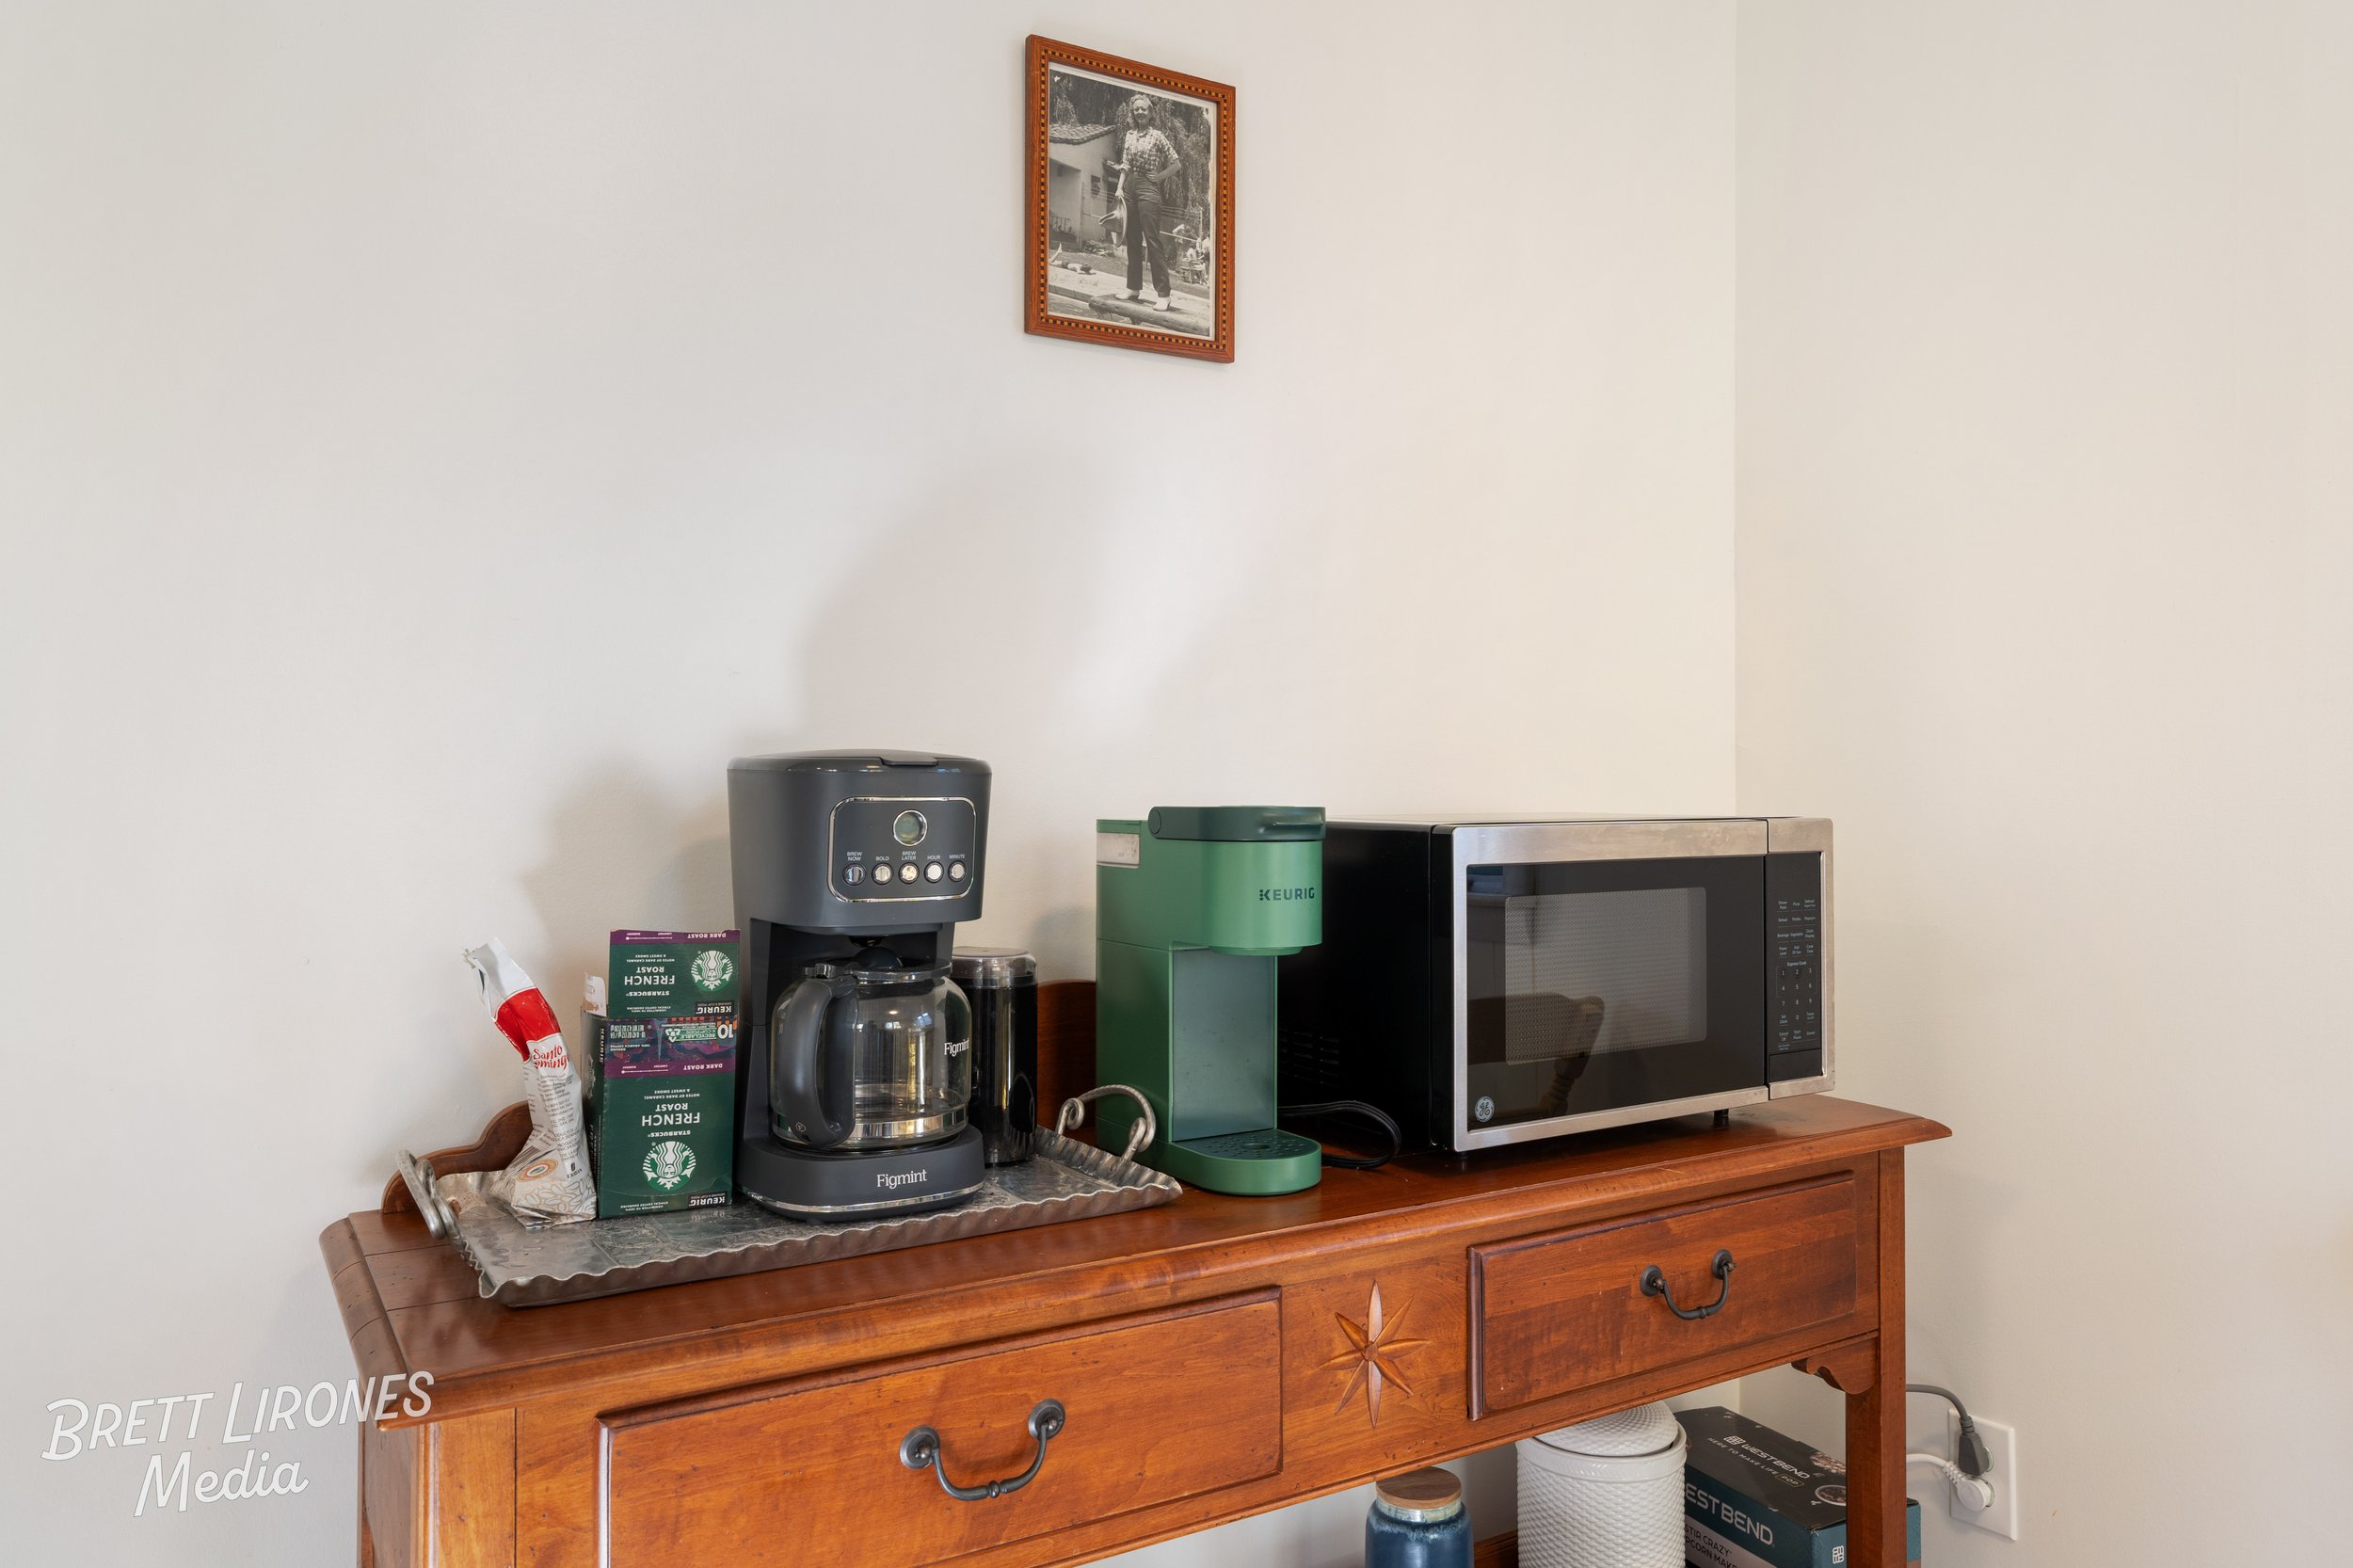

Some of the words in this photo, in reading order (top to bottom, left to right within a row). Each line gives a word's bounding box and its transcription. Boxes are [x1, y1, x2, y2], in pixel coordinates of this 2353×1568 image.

[1259, 888, 1315, 901] KEURIG
[624, 975, 675, 985] FRENCH
[718, 1024, 733, 1039] 10
[533, 1045, 563, 1060] Santo
[655, 1103, 688, 1112] ROAST
[642, 1112, 700, 1127] FRENCH
[877, 1169, 927, 1190] Figmint
[690, 1196, 725, 1206] KEURIG
[1707, 1437, 1727, 1448] HERE
[1738, 1454, 1761, 1465] MAKE
[1761, 1464, 1779, 1474] LIFE
[1781, 1476, 1799, 1484] POP
[1685, 1524, 1701, 1540] STIR
